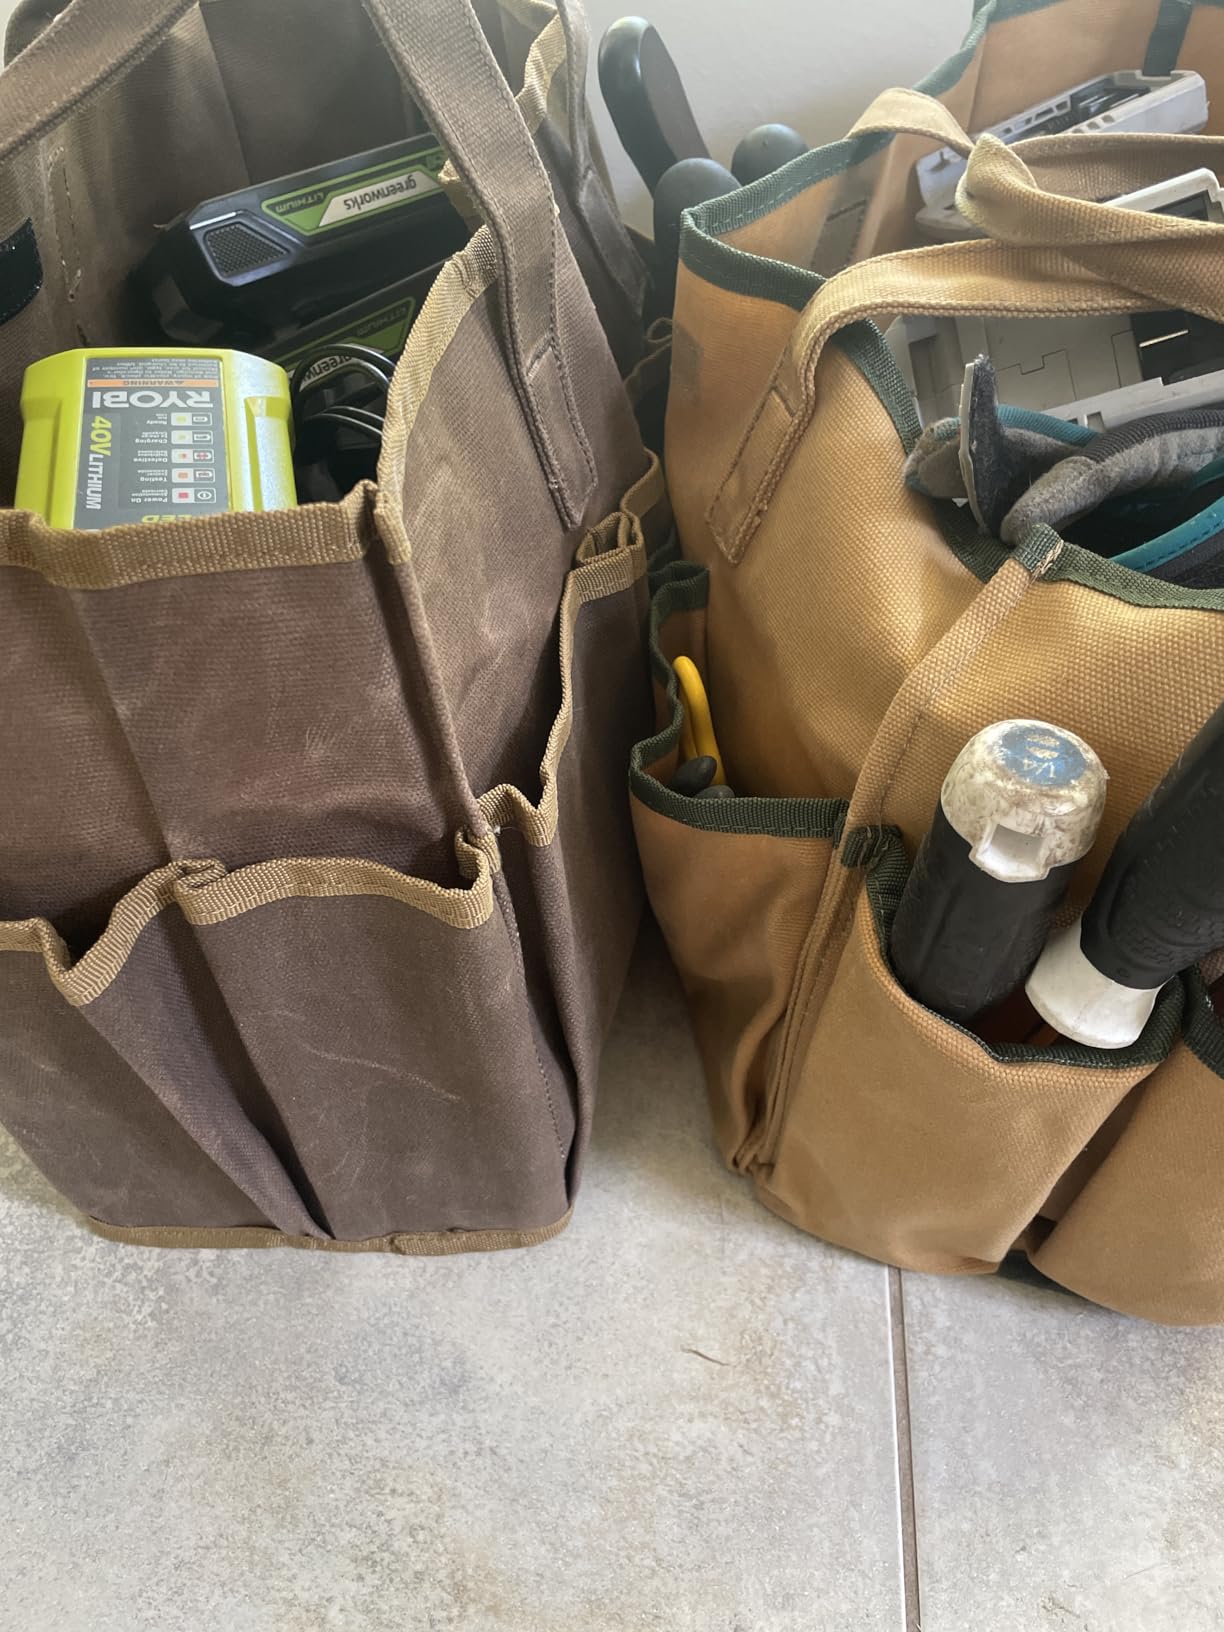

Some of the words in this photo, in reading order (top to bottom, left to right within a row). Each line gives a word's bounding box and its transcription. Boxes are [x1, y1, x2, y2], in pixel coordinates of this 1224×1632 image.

[343, 174, 417, 211] greenworks
[92, 390, 214, 409] RYOBI
[90, 415, 113, 456] 40V
[86, 454, 104, 510] LITHIUM
